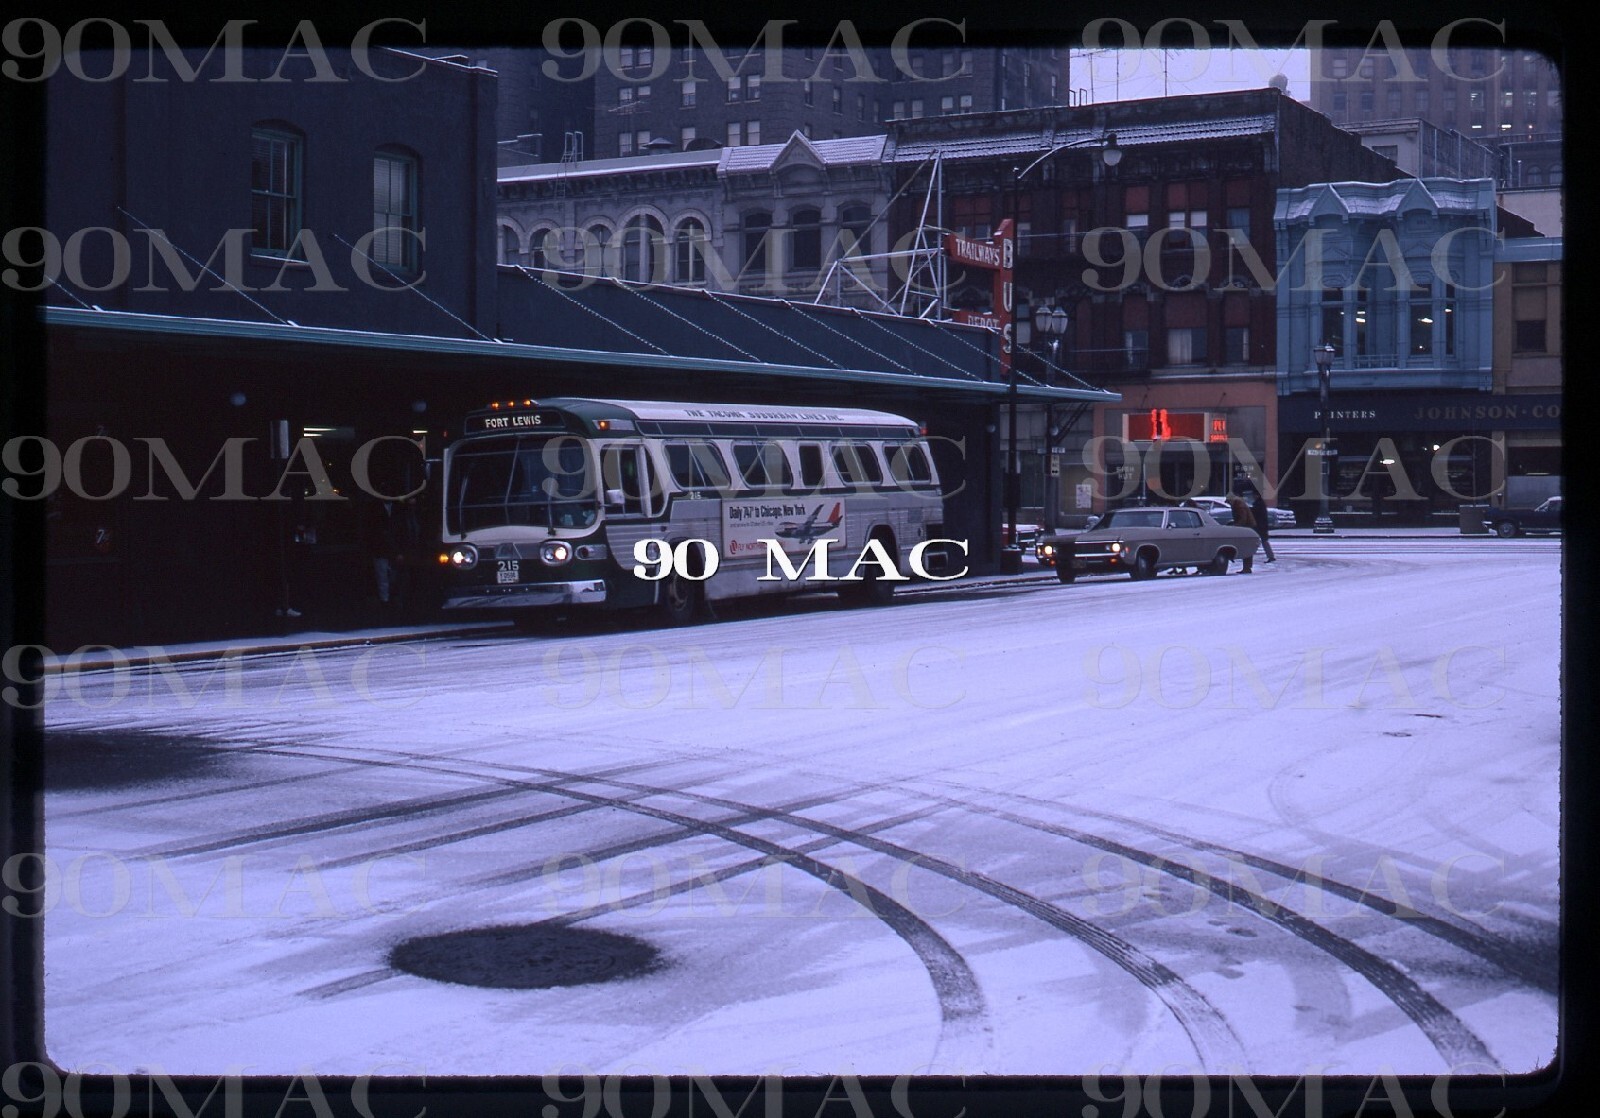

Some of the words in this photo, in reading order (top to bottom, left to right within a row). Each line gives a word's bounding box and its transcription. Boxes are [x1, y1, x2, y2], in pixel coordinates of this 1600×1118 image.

[955, 238, 1000, 267] TRAILWAYS
[1002, 238, 1013, 354] BUS
[967, 314, 999, 329] DEPOT
[685, 409, 705, 418] THE
[707, 410, 745, 418] TACOMA
[748, 411, 798, 420] SUBURBAN
[798, 413, 826, 421] LINES
[1313, 410, 1376, 420] PINTERS
[1414, 404, 1518, 420] JOHNSON
[485, 417, 509, 428] FORT
[512, 415, 541, 427] LEWIS
[729, 506, 742, 520] Daily
[755, 506, 760, 518] to
[783, 504, 794, 517] New
[794, 503, 806, 516] York
[497, 560, 519, 571] 215
